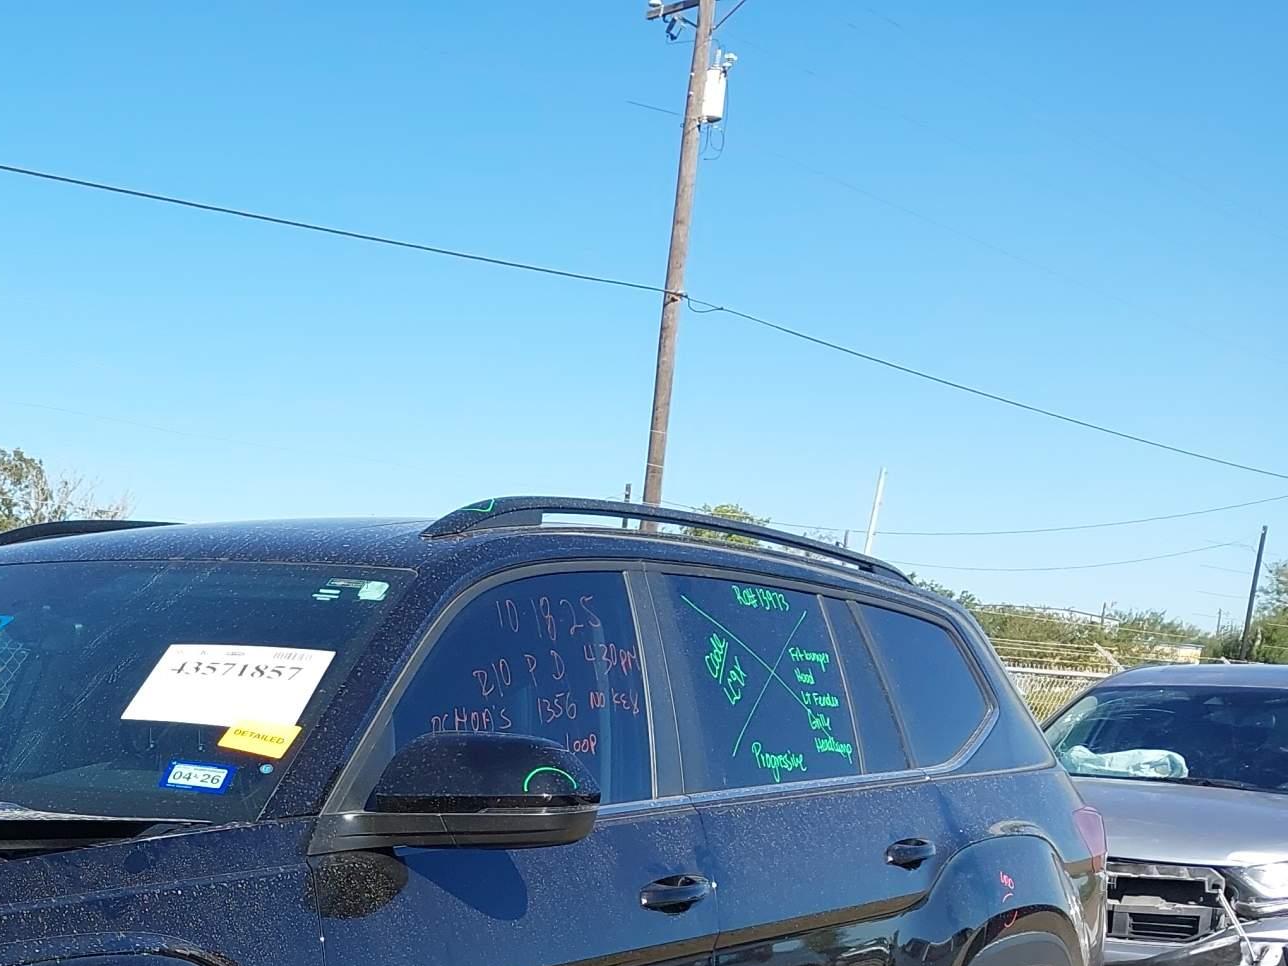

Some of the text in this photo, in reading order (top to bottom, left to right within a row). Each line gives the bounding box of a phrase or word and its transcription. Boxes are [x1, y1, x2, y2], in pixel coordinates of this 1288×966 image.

[169, 660, 304, 681] 43571857
[537, 692, 577, 723] 1356
[233, 728, 285, 745] DETAILED
[751, 741, 808, 783] Progressive
